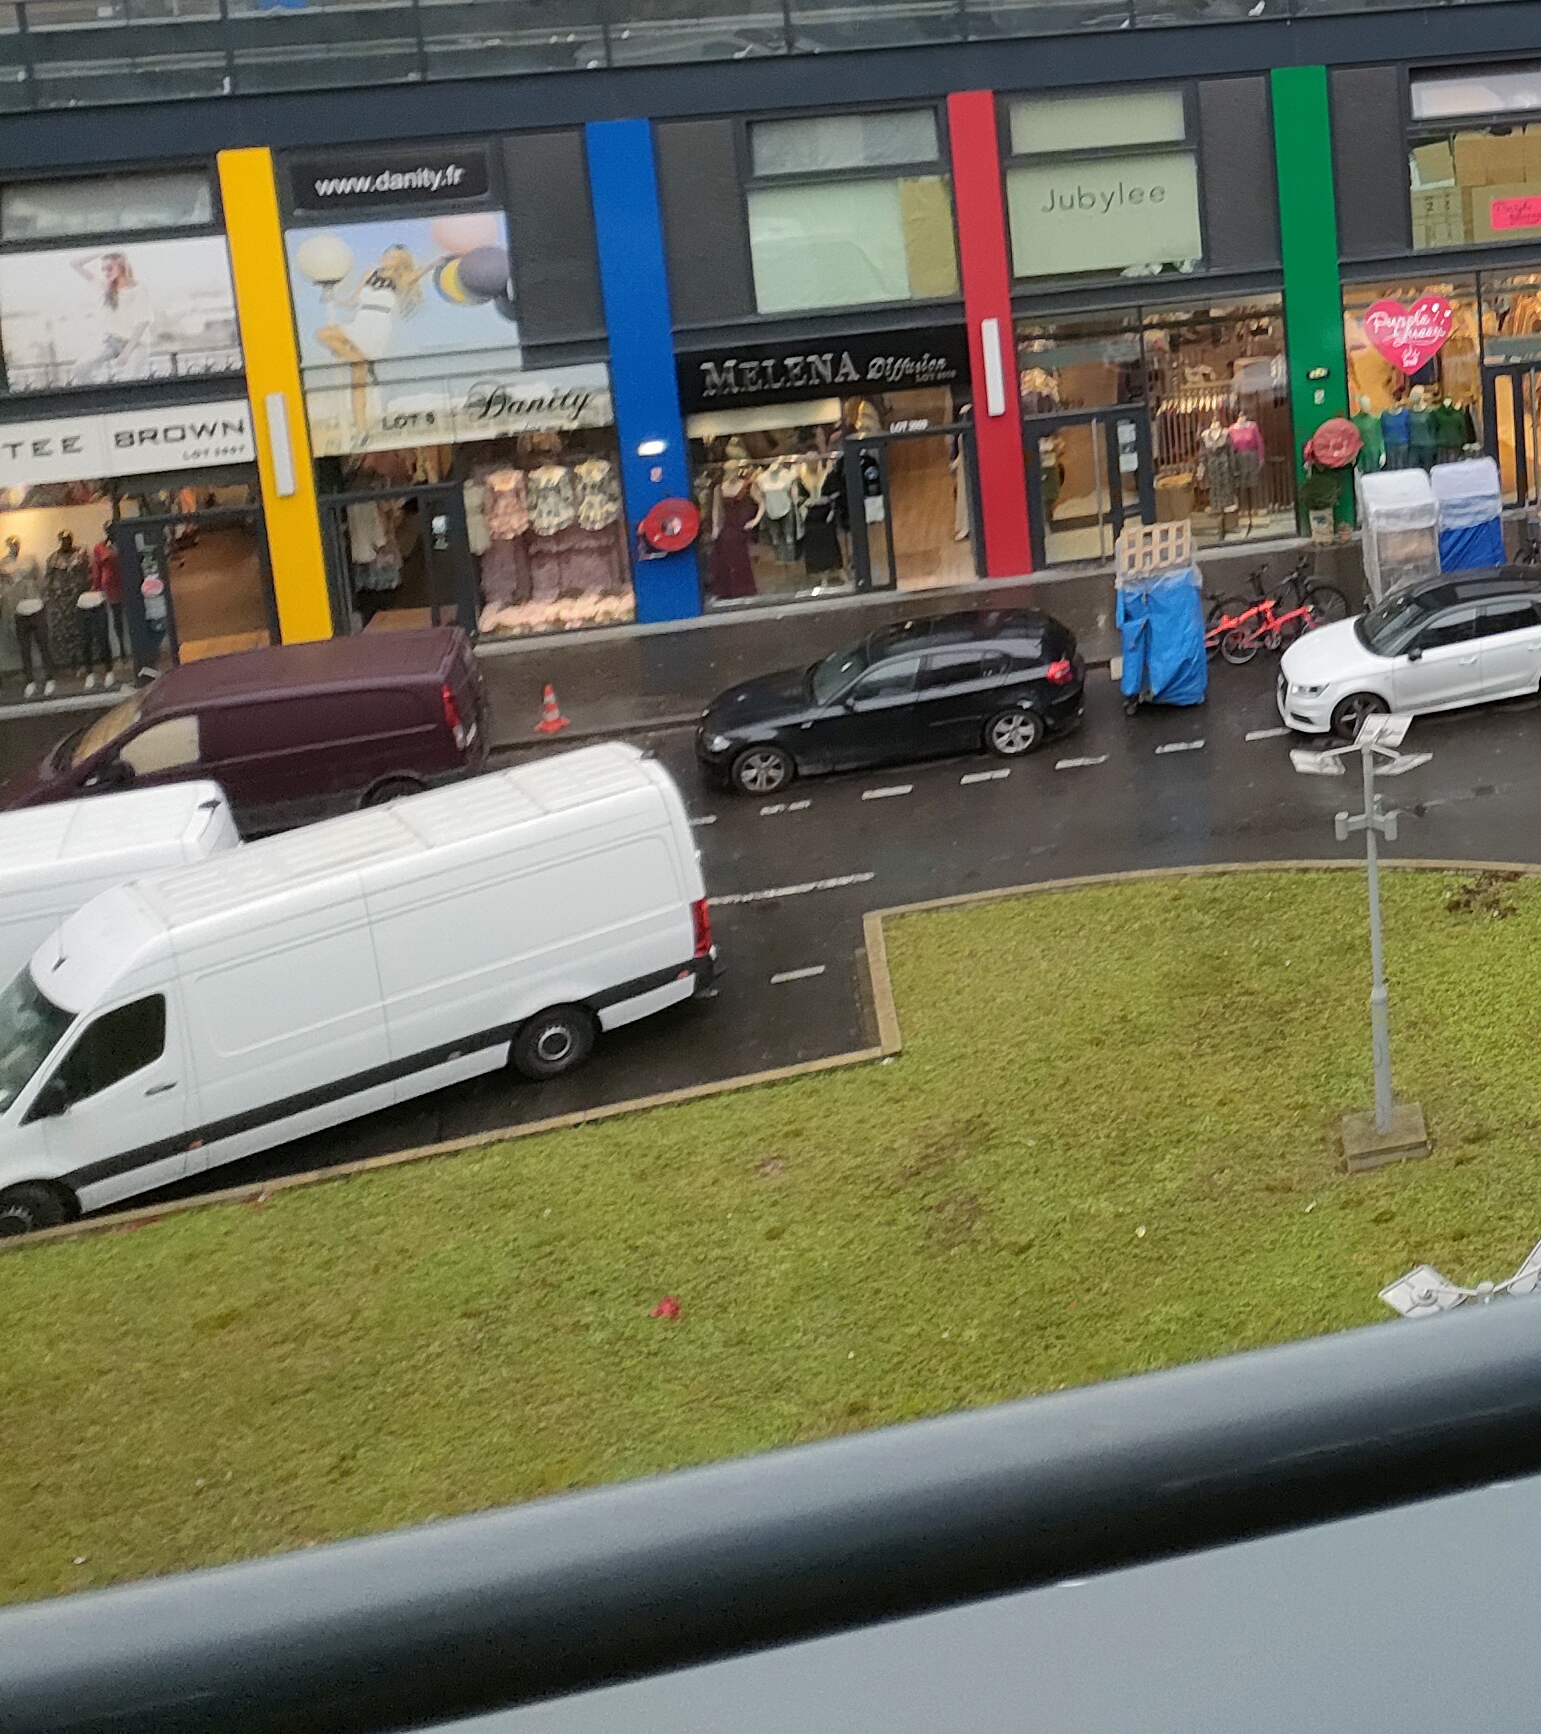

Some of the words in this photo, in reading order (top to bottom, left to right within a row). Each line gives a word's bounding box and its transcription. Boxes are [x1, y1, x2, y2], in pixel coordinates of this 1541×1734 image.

[315, 164, 464, 197] www.danity.fr
[1040, 181, 1166, 214] Jubylee
[700, 351, 860, 398] MELENA
[866, 353, 947, 383] Diffusion
[464, 380, 596, 421] Danity
[1, 435, 84, 460] TEE
[114, 418, 246, 449] BROWN
